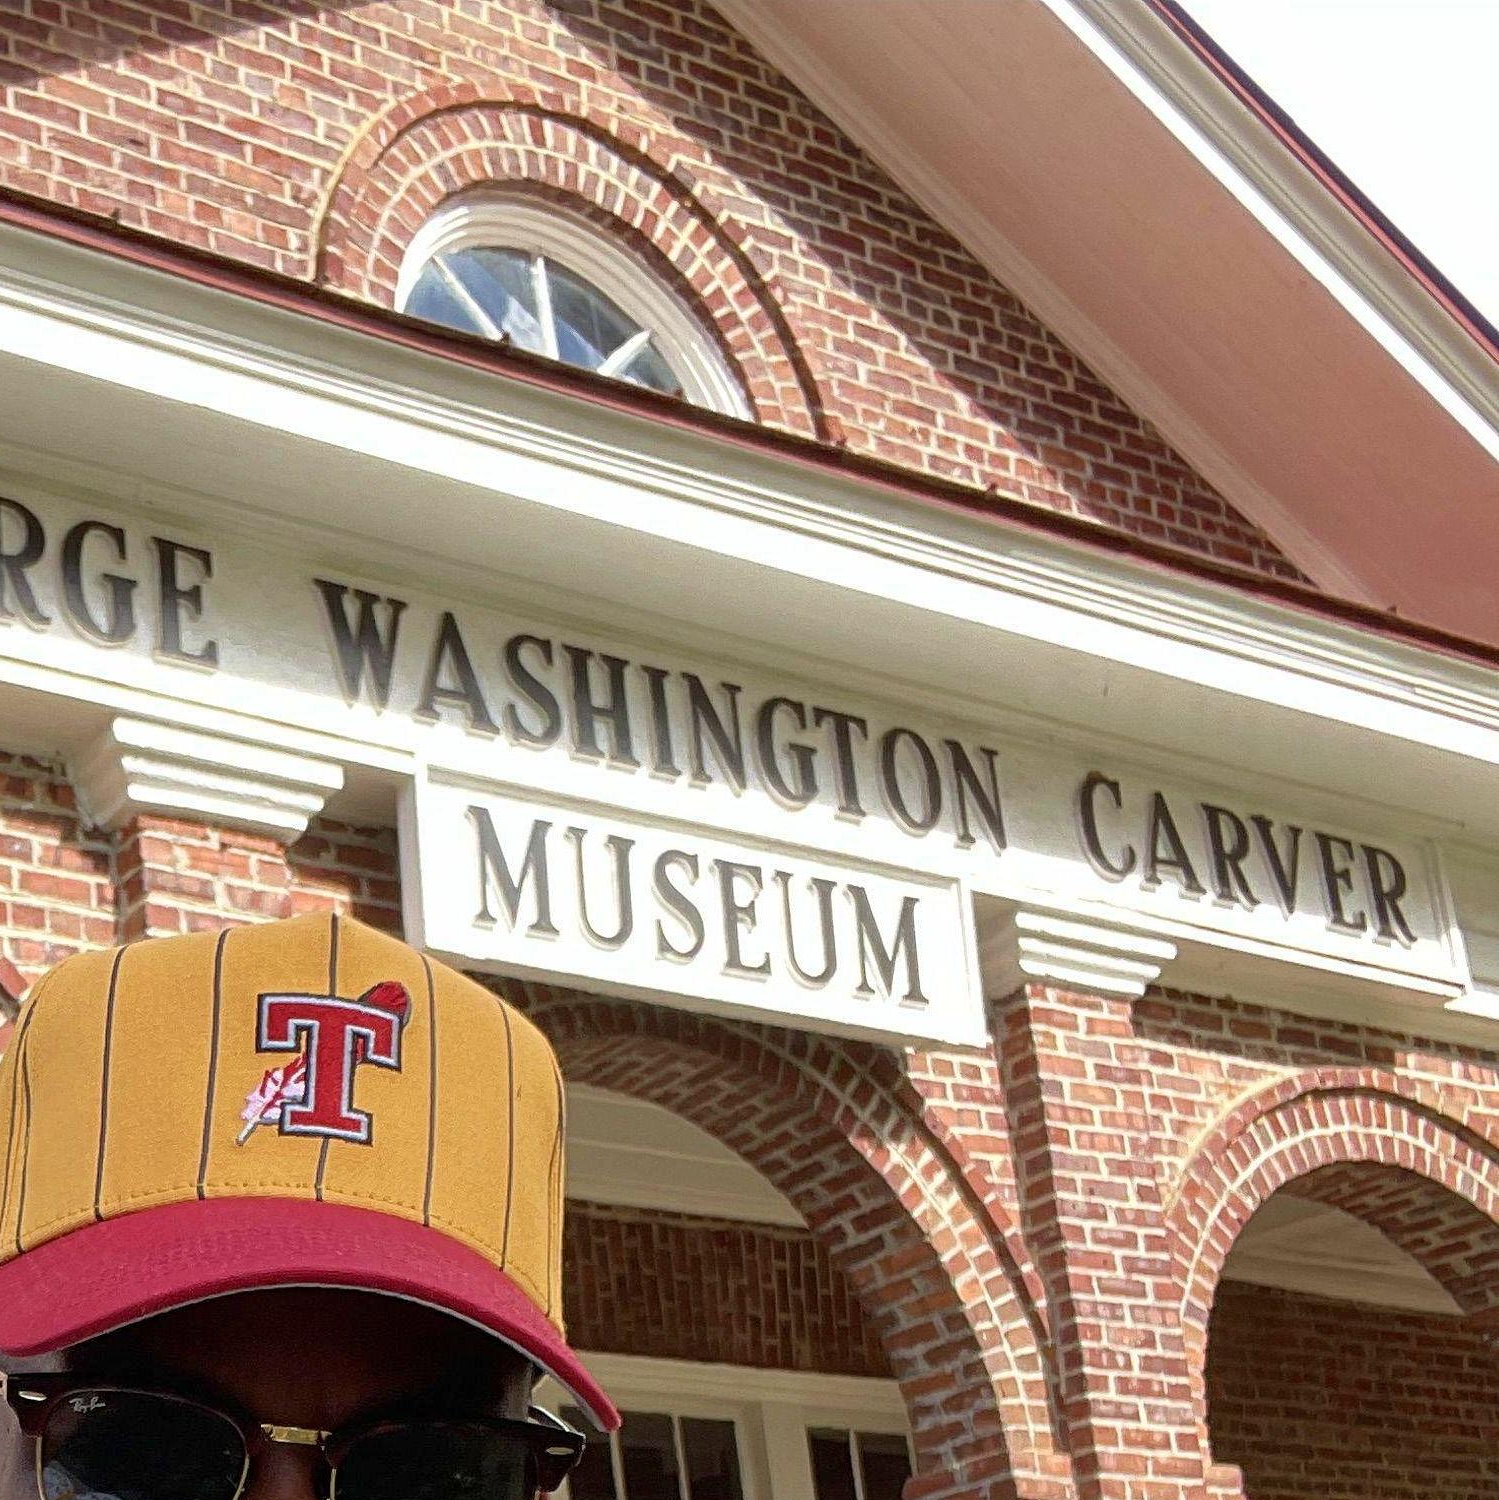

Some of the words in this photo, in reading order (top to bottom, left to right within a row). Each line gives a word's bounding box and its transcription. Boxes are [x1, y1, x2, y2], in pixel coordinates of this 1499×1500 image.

[313, 578, 1007, 857] WASHINGTON
[1077, 770, 1418, 949] CARVER
[464, 805, 930, 1008] MUSEUM
[256, 993, 403, 1146] T
